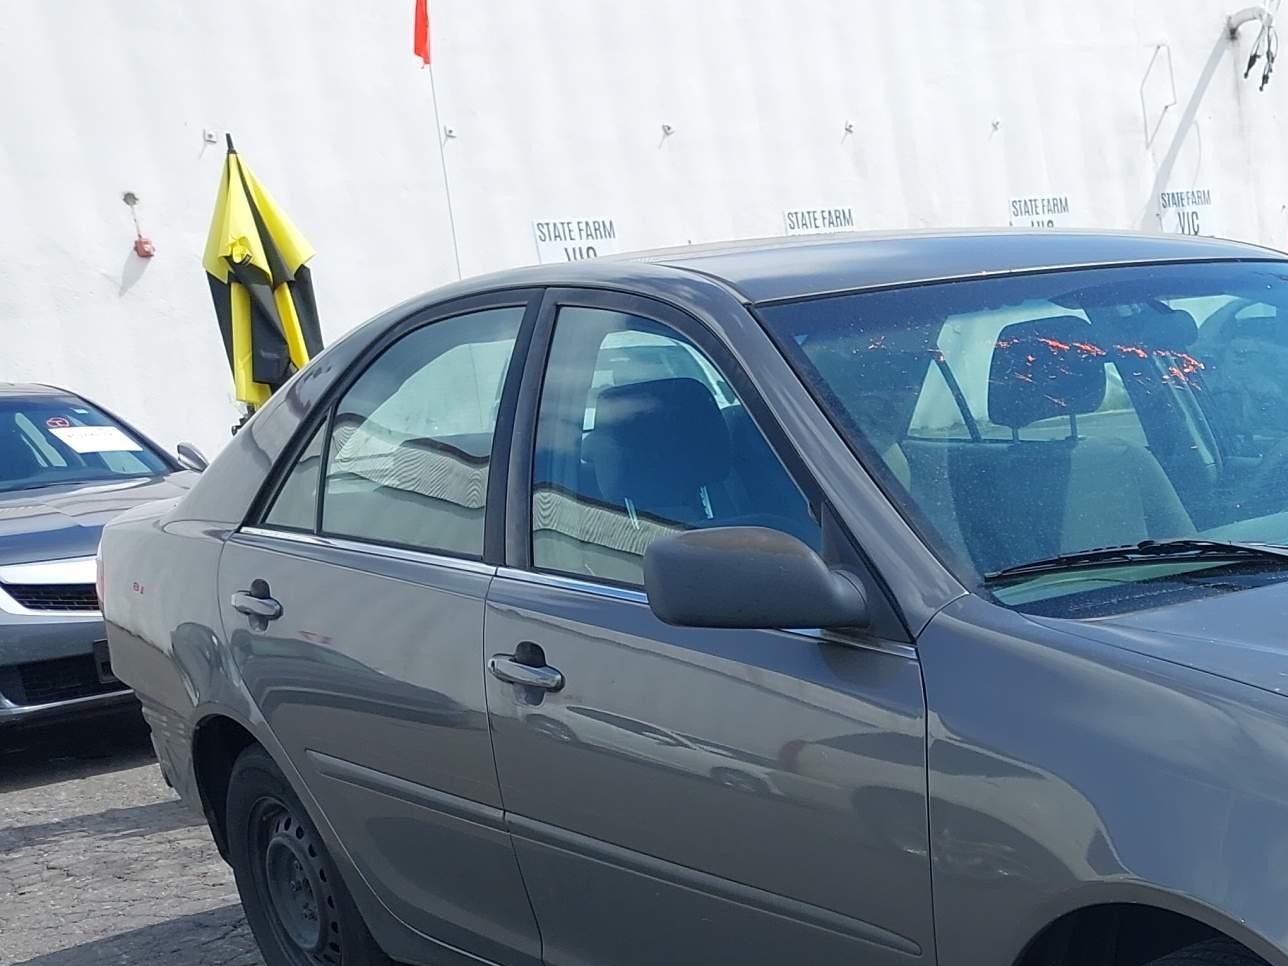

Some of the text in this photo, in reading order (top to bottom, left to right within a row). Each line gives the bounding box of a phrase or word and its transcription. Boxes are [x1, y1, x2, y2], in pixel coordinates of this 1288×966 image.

[1011, 196, 1070, 217] STATE FARM
[1160, 189, 1211, 209] STATE FARM
[786, 208, 854, 230] STATE FARM
[1177, 210, 1200, 236] VIC
[536, 219, 616, 242] STATE FARM
